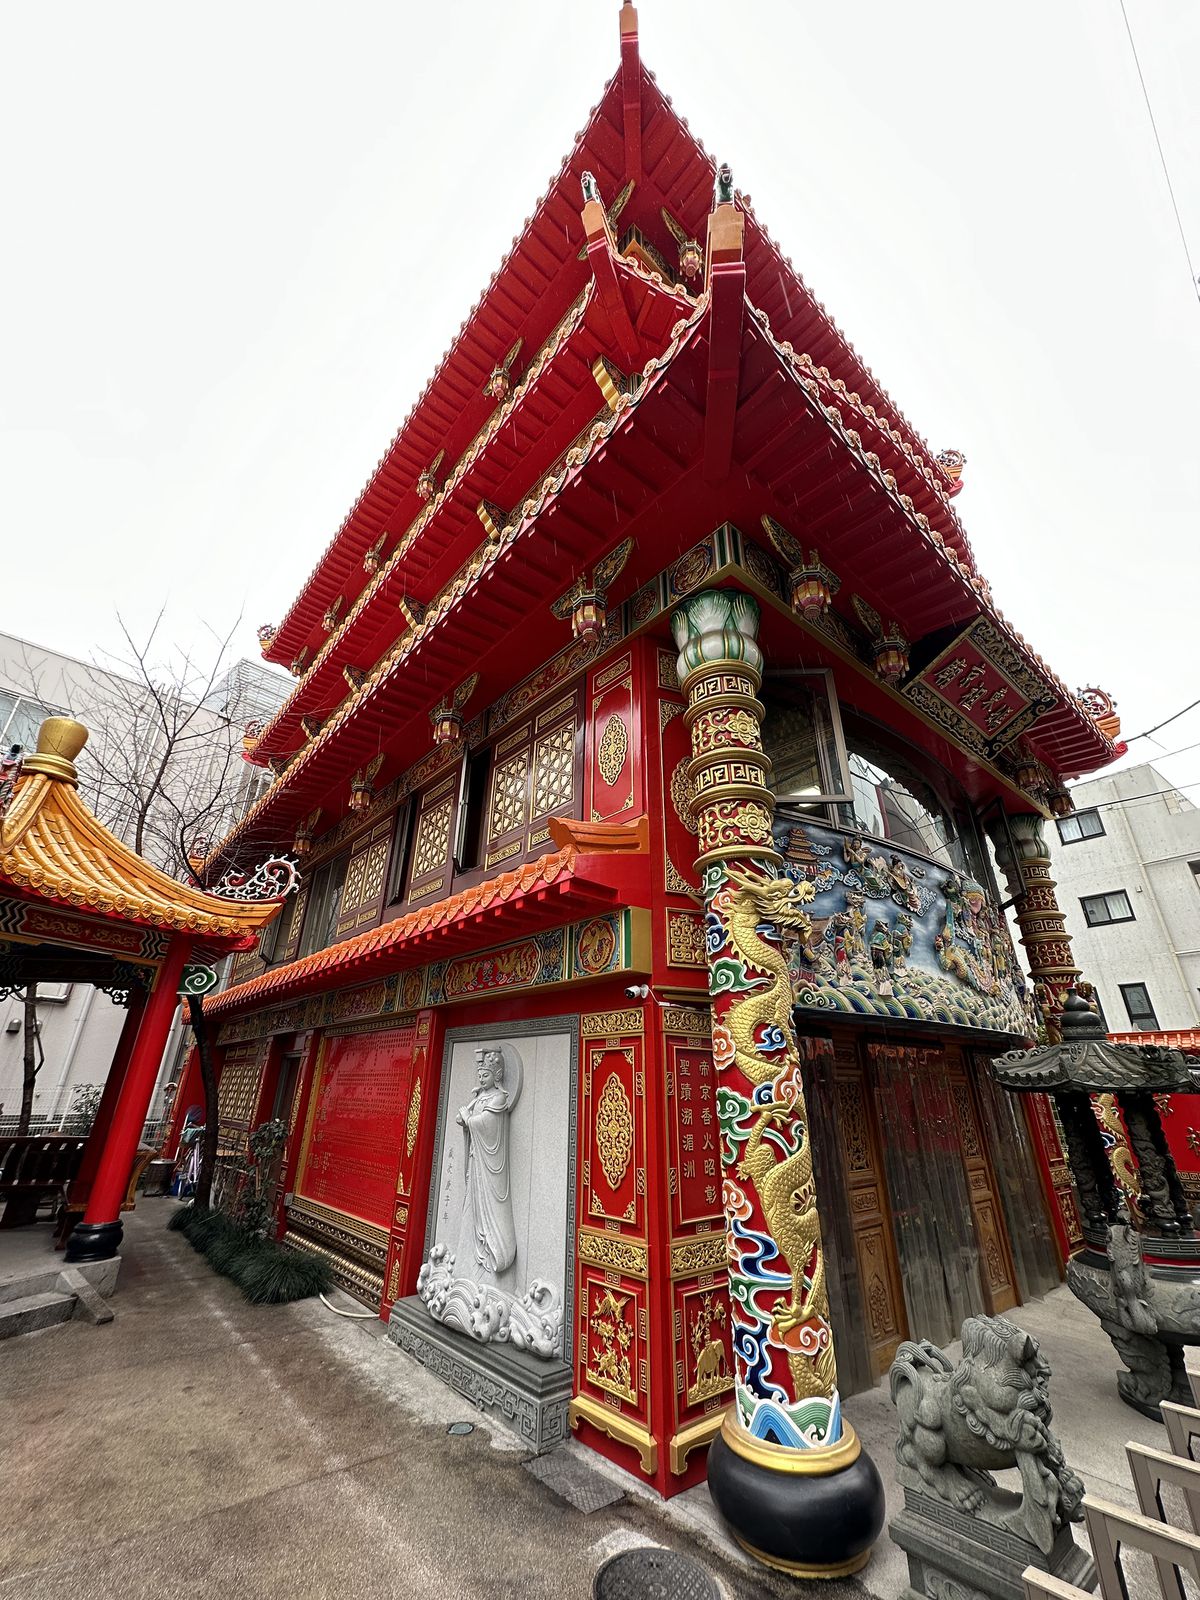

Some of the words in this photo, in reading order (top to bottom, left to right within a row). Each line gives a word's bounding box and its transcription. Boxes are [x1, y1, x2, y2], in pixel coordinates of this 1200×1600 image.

[699, 1060, 717, 1203] 帝京香火昭彰
